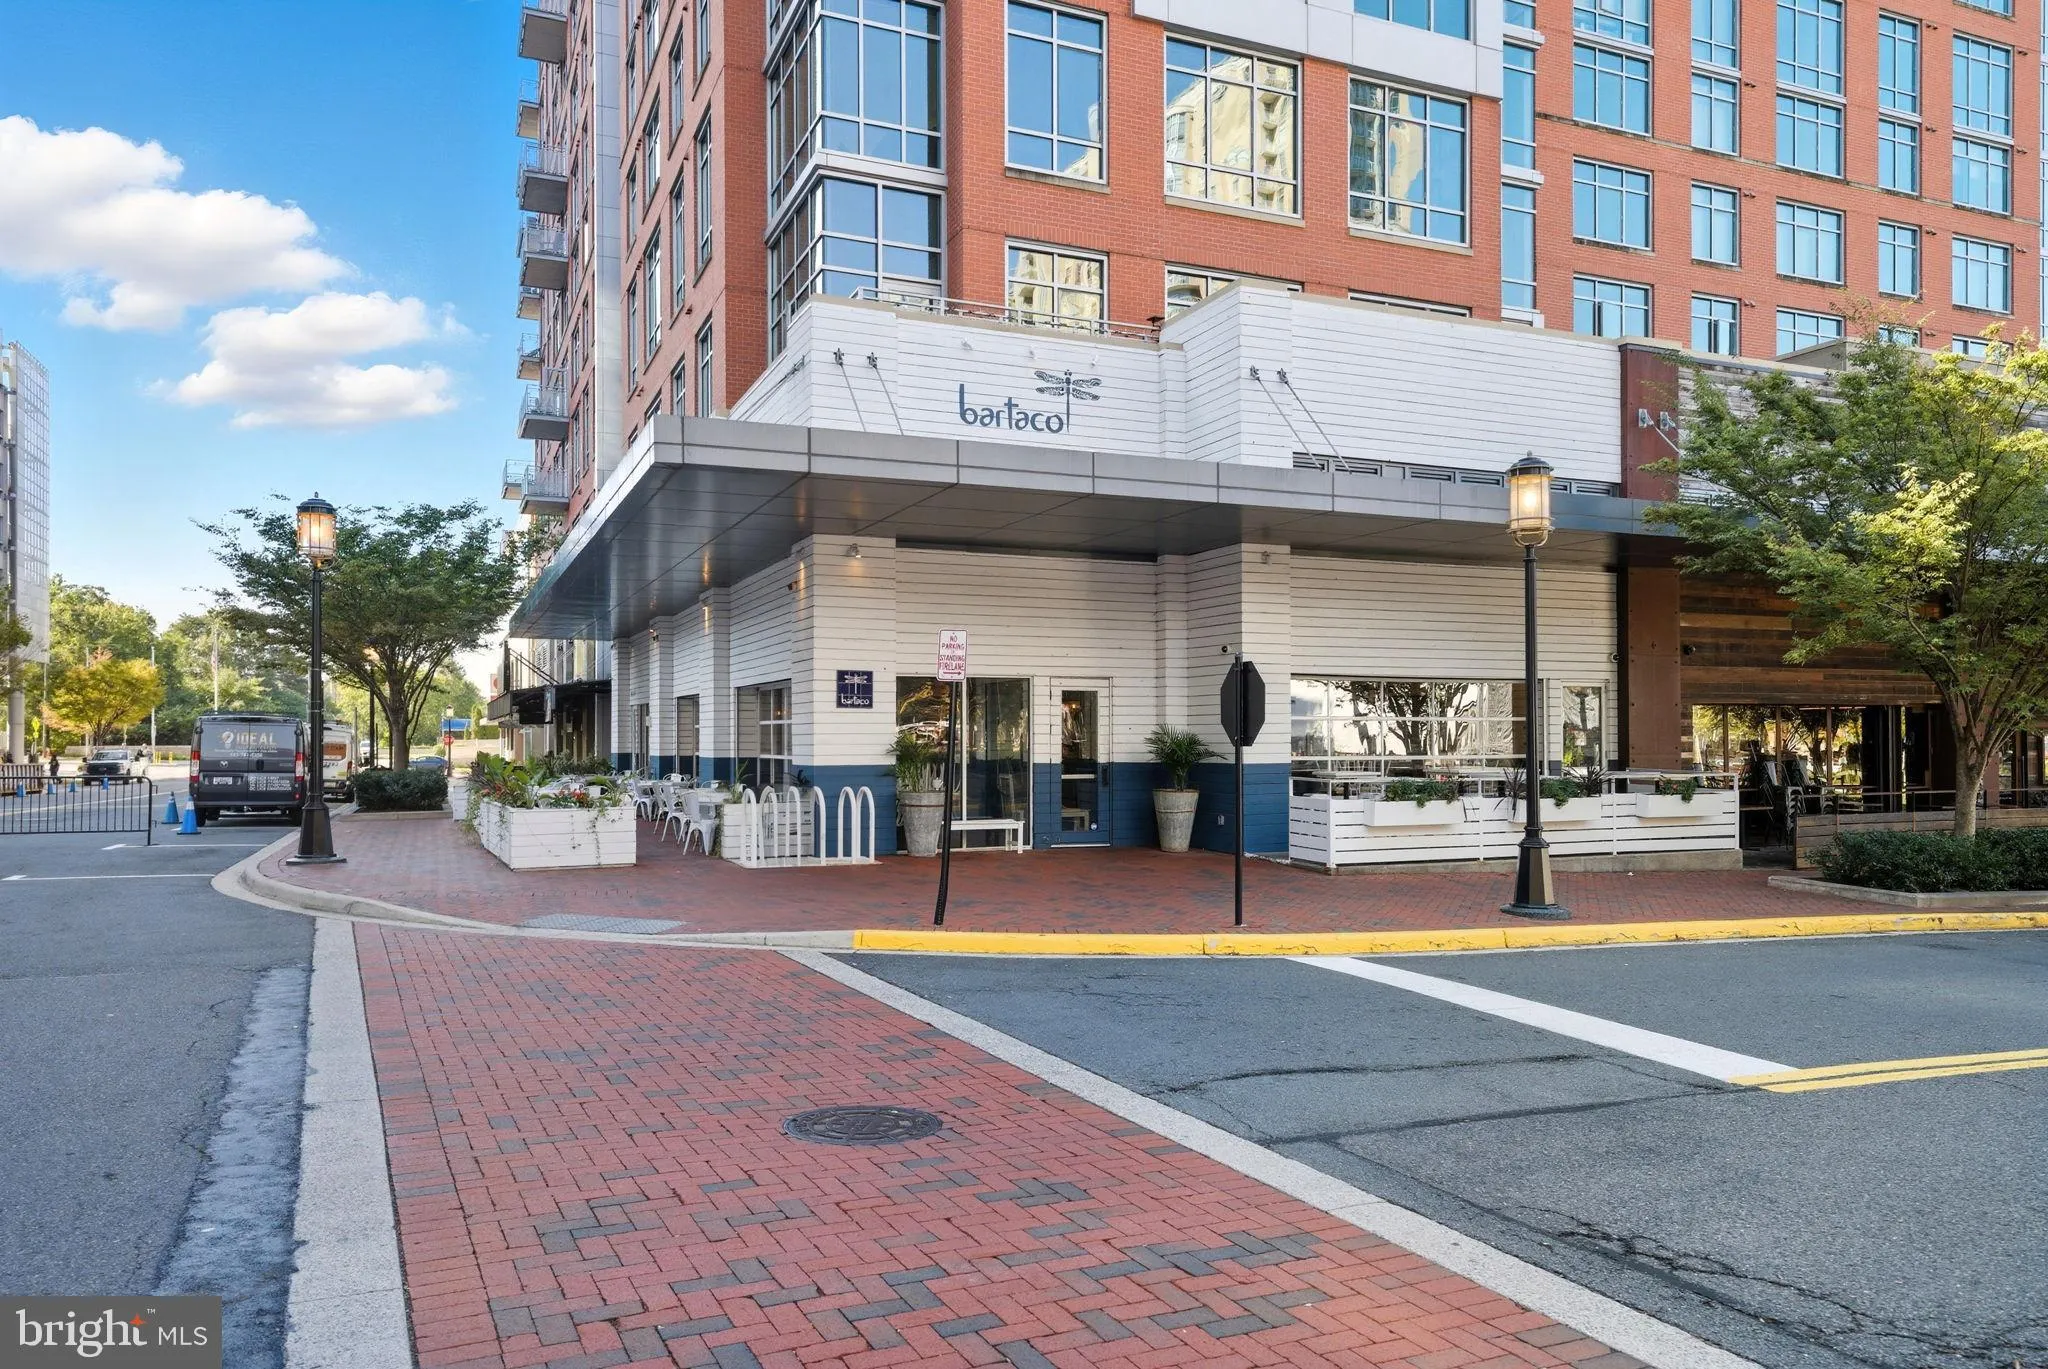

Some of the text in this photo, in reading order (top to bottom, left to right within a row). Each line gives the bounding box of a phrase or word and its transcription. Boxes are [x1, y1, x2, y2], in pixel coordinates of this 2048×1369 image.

[958, 383, 1064, 434] bartaco
[939, 654, 965, 662] STANDING
[841, 694, 870, 705] bartaco
[236, 732, 277, 745] IDEAL
